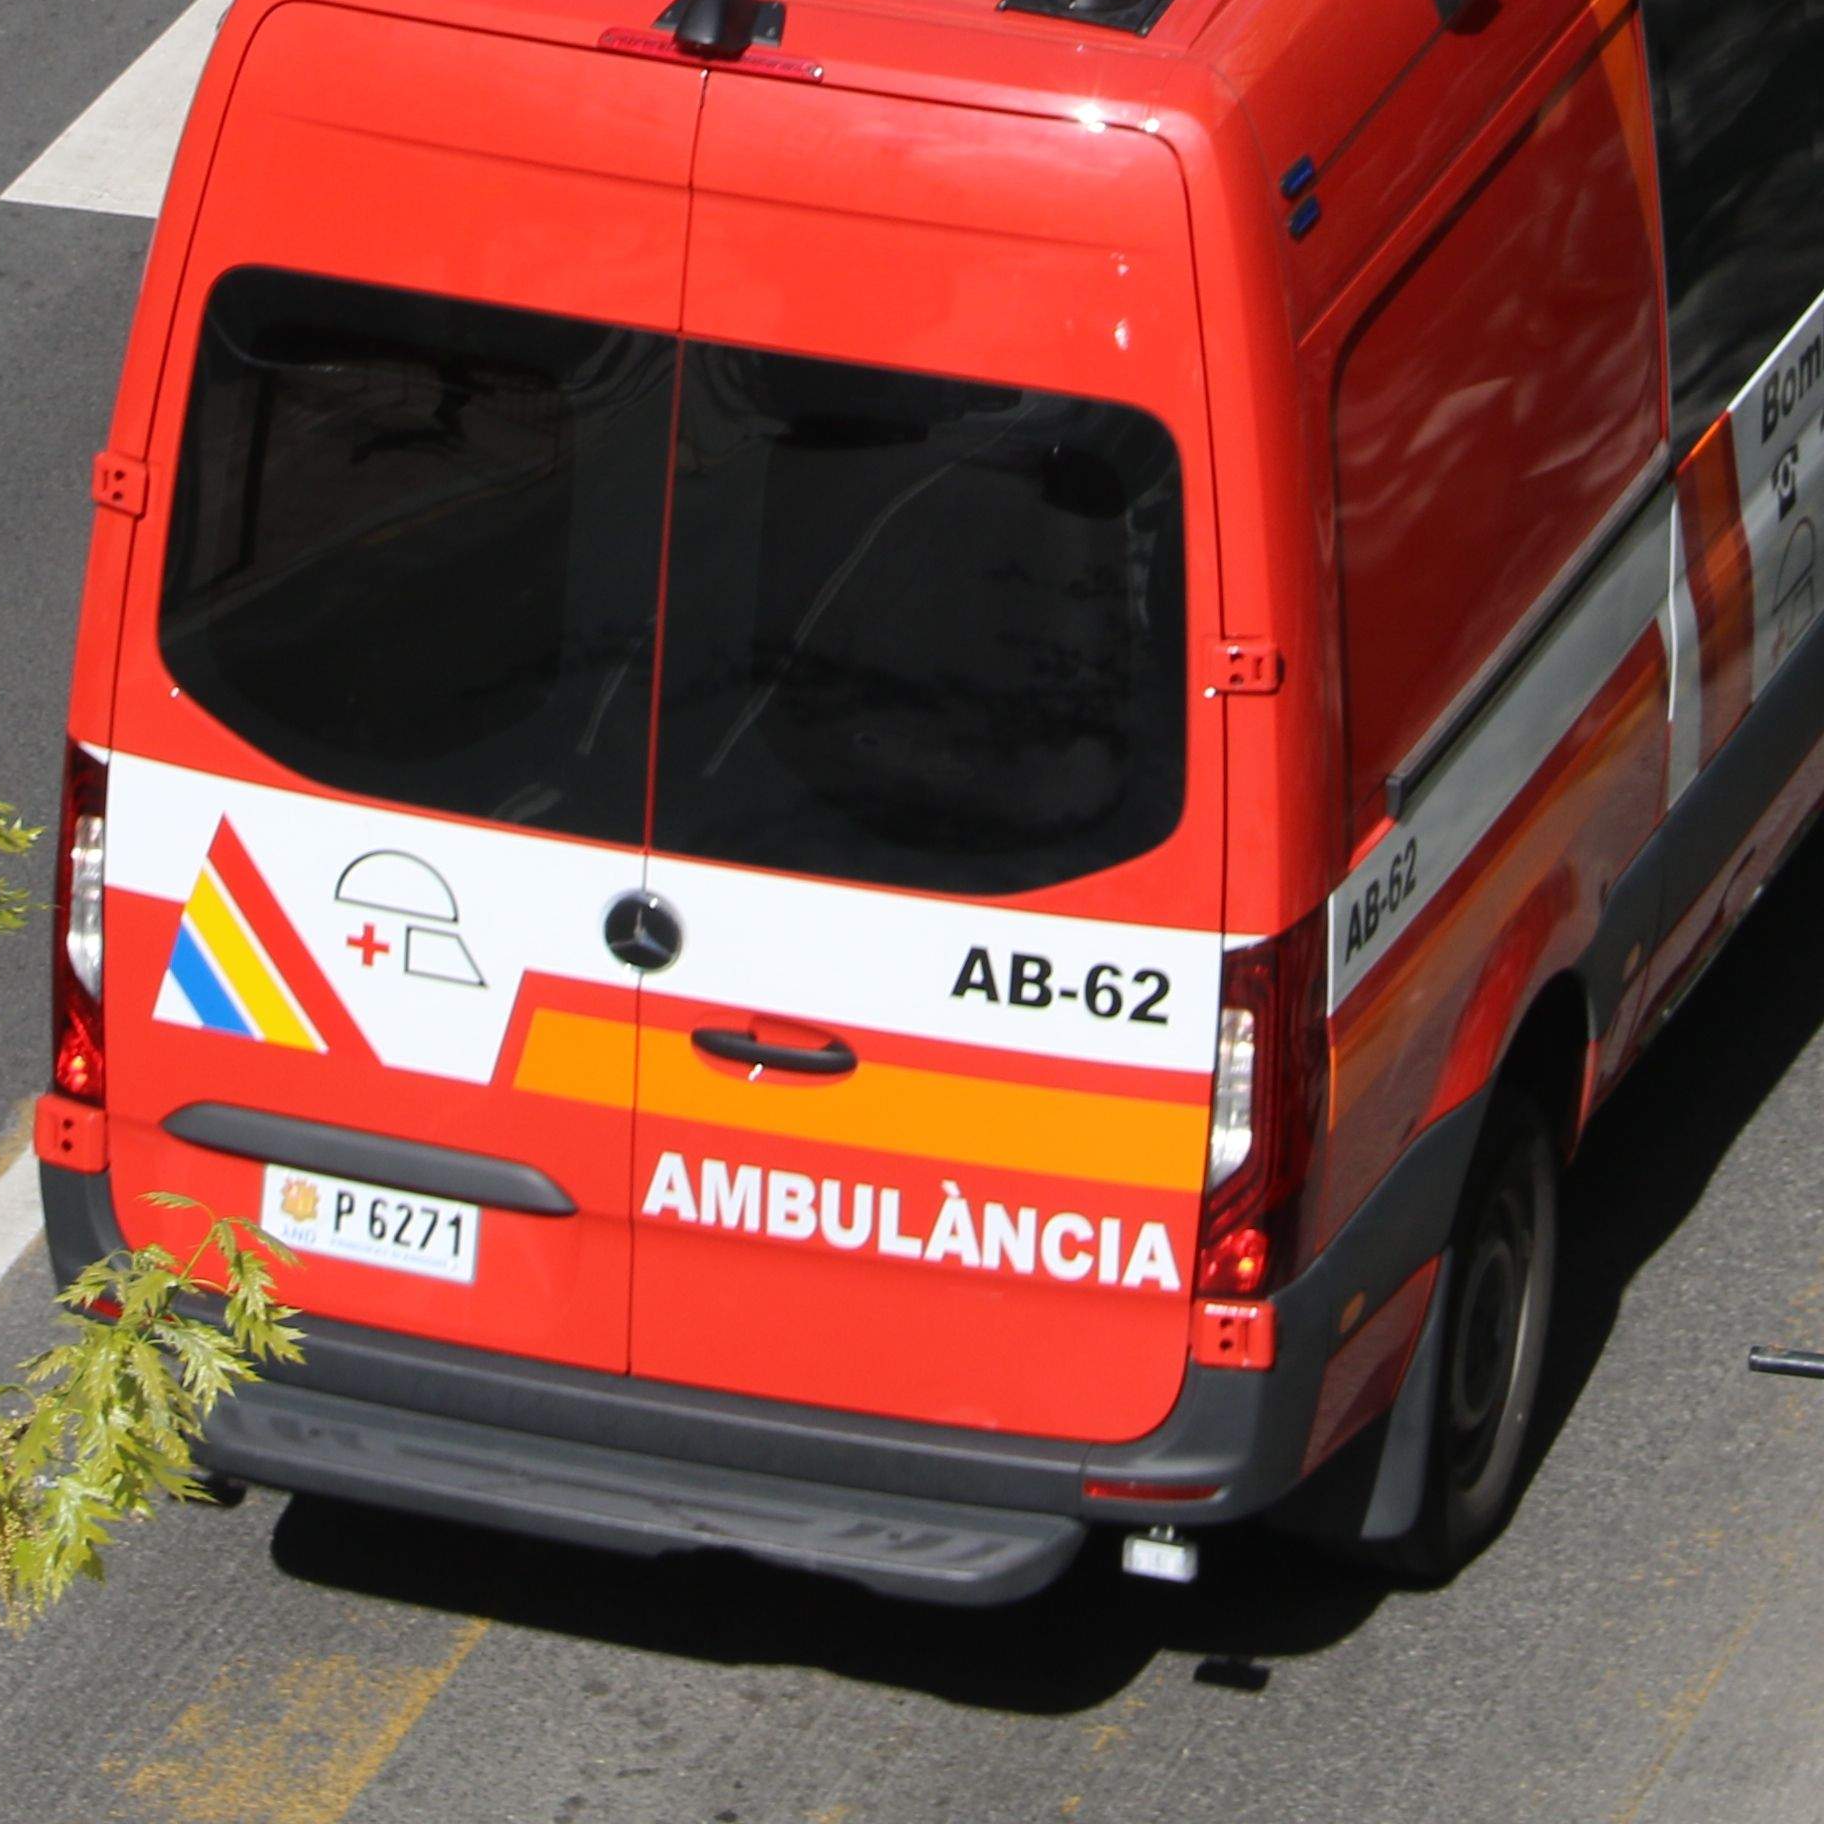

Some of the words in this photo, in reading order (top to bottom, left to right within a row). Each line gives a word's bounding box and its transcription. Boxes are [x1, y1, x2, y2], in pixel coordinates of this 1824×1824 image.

[1344, 836, 1417, 966] AB-62
[950, 945, 1171, 1026] AB-62
[334, 1190, 355, 1233] P
[368, 1197, 464, 1258] 6271
[641, 1151, 1182, 1293] AMBULÀNCIA
